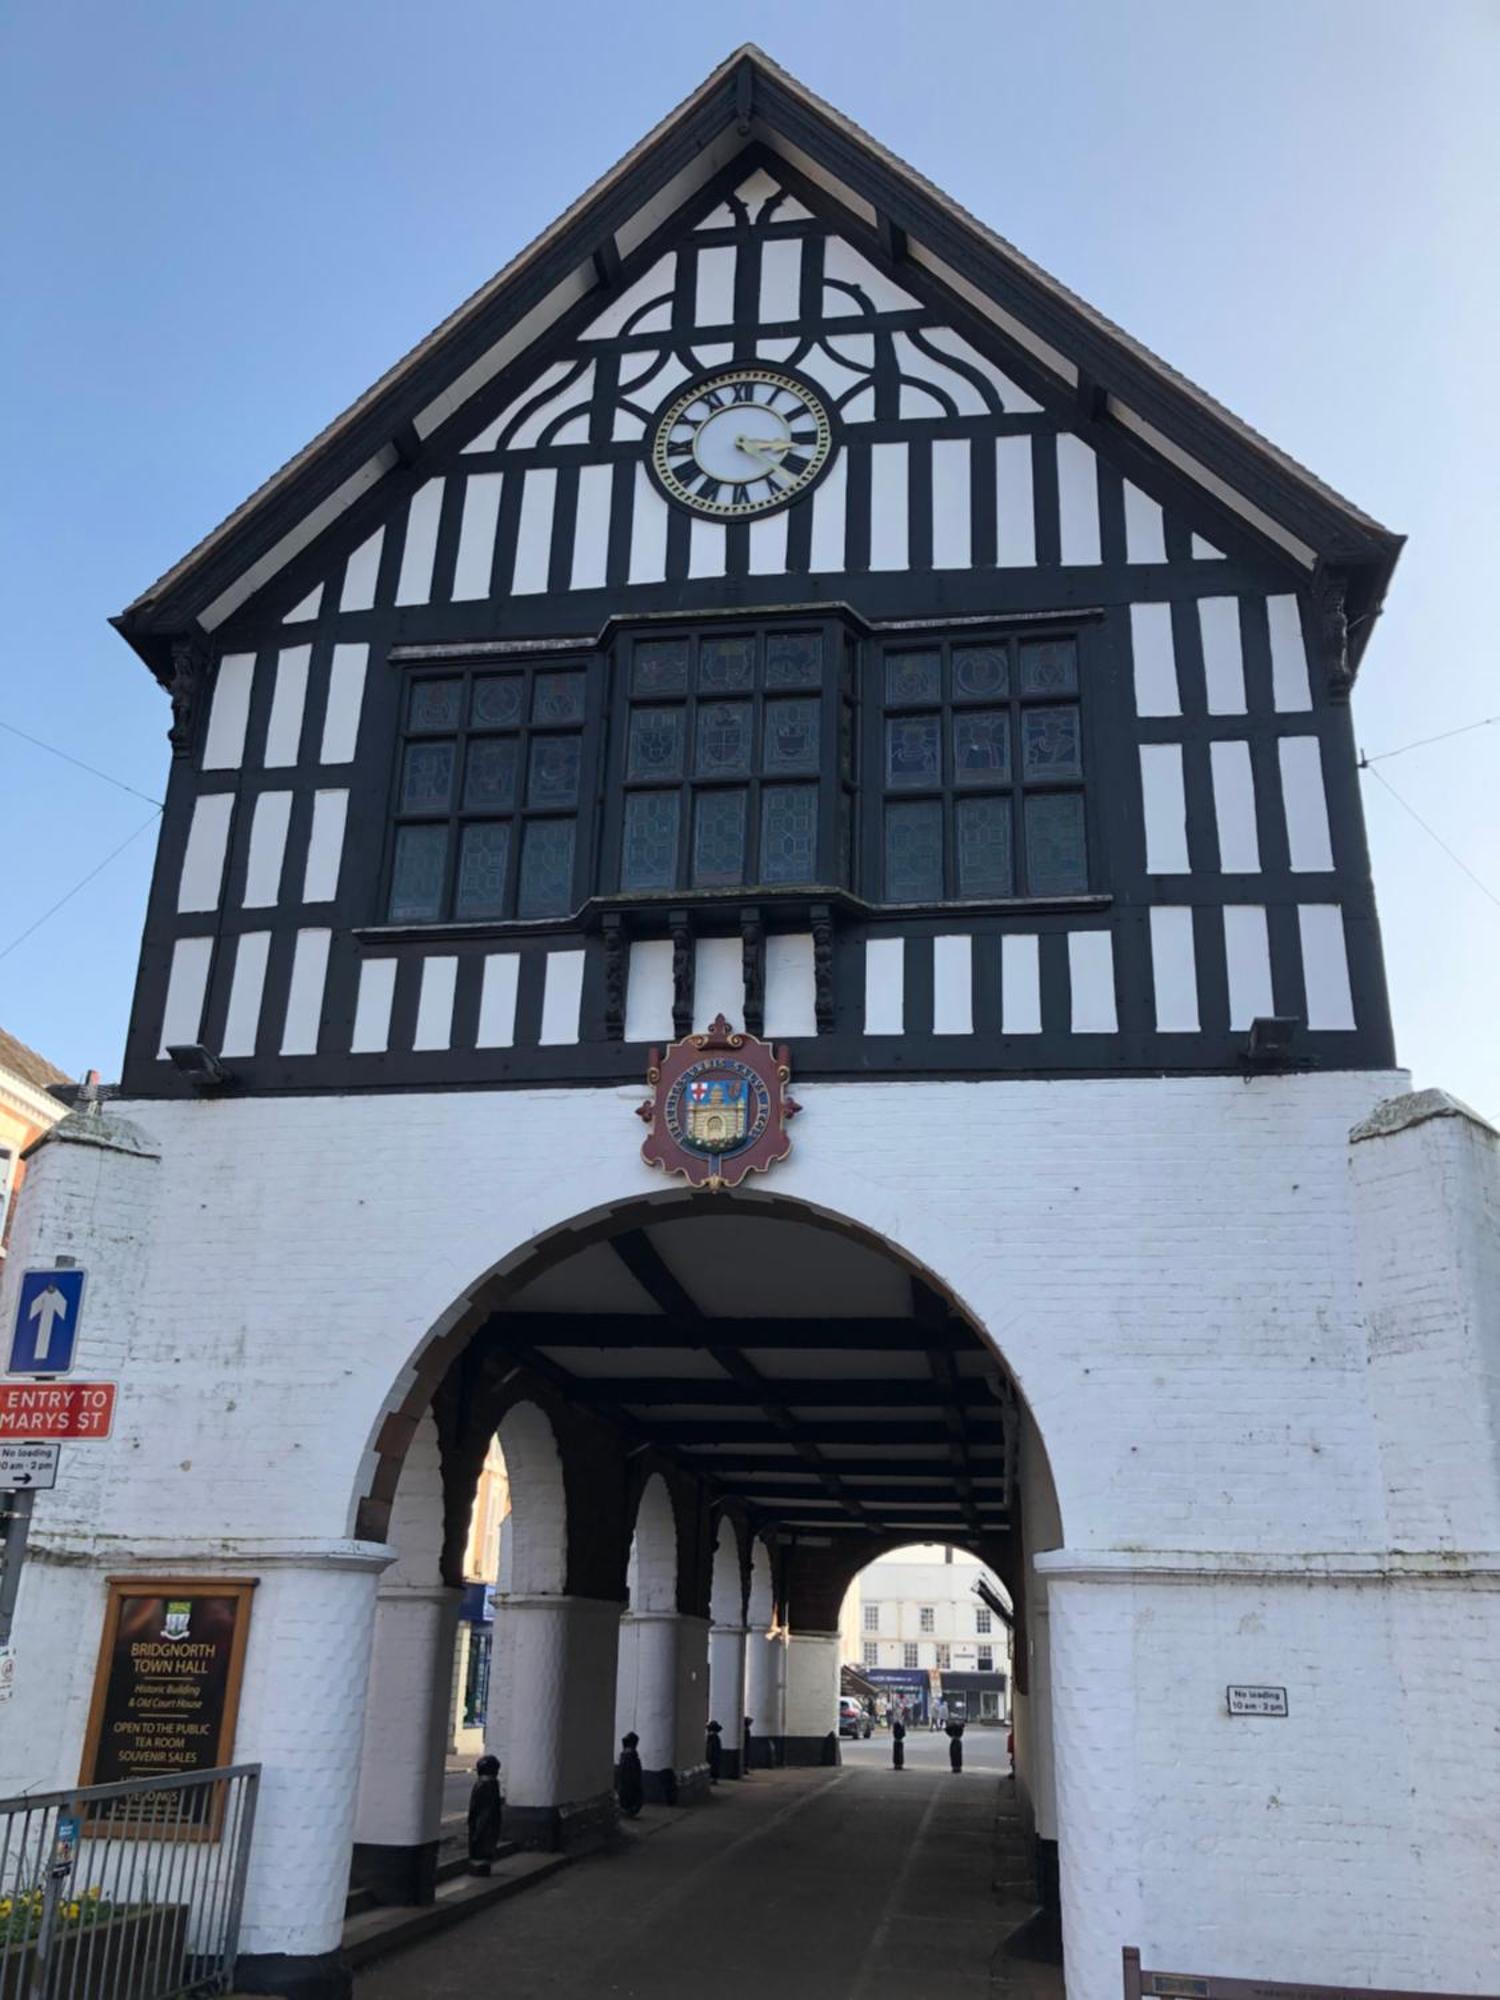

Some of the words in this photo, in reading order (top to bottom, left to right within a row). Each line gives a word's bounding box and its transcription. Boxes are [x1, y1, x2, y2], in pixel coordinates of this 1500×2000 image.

[8, 1391, 75, 1408] ENTRY
[81, 1391, 107, 1408] TO
[0, 1412, 70, 1430] MARYS
[77, 1412, 102, 1430] ST
[2, 1449, 16, 1457] No
[18, 1449, 52, 1458] loading
[30, 1461, 37, 1470] 2
[38, 1462, 53, 1471] pm
[131, 1643, 215, 1657] BRIDGNORTH
[133, 1659, 173, 1673] TOWN
[175, 1660, 208, 1674] HALL
[134, 1684, 165, 1694] Historic
[166, 1684, 201, 1696] Building
[1234, 1690, 1247, 1698] No
[1249, 1691, 1280, 1701] loading
[136, 1698, 152, 1708] Old
[153, 1698, 176, 1708] Court
[177, 1699, 203, 1708] House
[114, 1722, 141, 1733] OPEN
[142, 1722, 155, 1733] TO
[156, 1723, 175, 1734] THE
[176, 1723, 211, 1735] PUBLIC
[135, 1737, 152, 1746] TEA
[154, 1737, 184, 1748] ROOM
[118, 1750, 166, 1762] SOUVENIR
[168, 1752, 197, 1763] SALES
